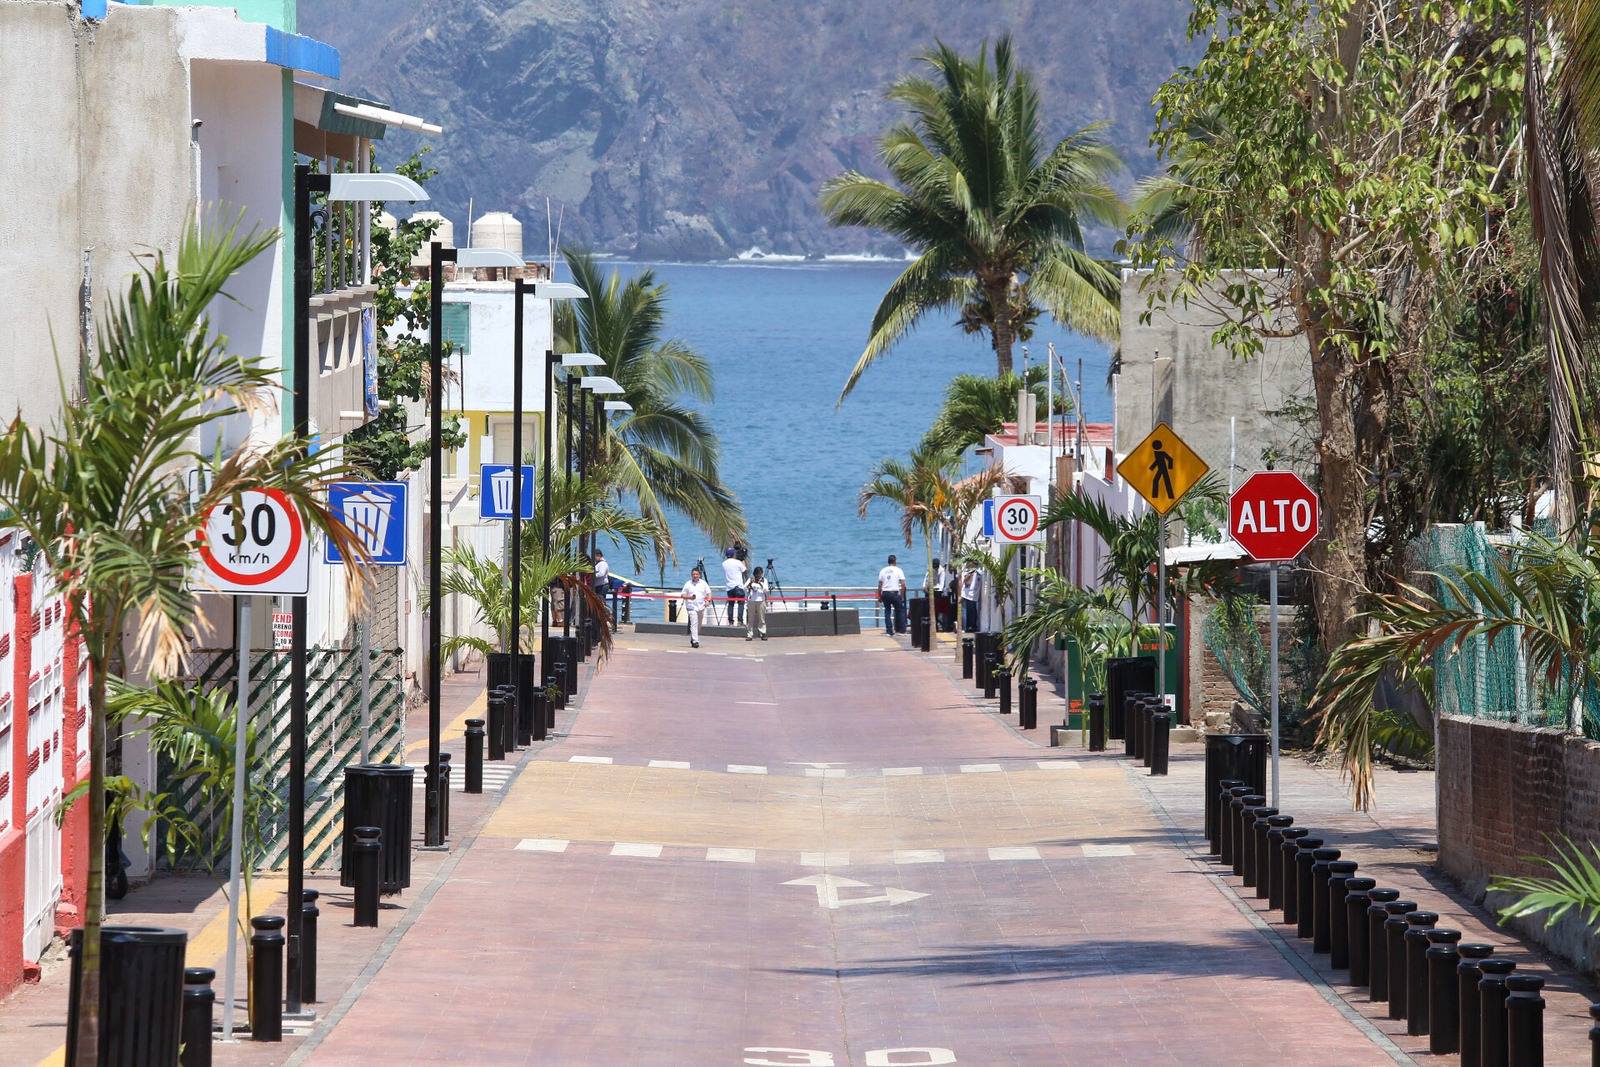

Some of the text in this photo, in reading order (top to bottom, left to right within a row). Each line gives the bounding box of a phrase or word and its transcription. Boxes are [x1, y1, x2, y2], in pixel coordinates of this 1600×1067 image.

[221, 503, 276, 547] 30
[1007, 508, 1028, 525] 30
[1237, 498, 1311, 534] ALTO
[228, 552, 270, 564] km/h
[271, 614, 292, 623] VEND
[743, 1047, 957, 1067] 30
